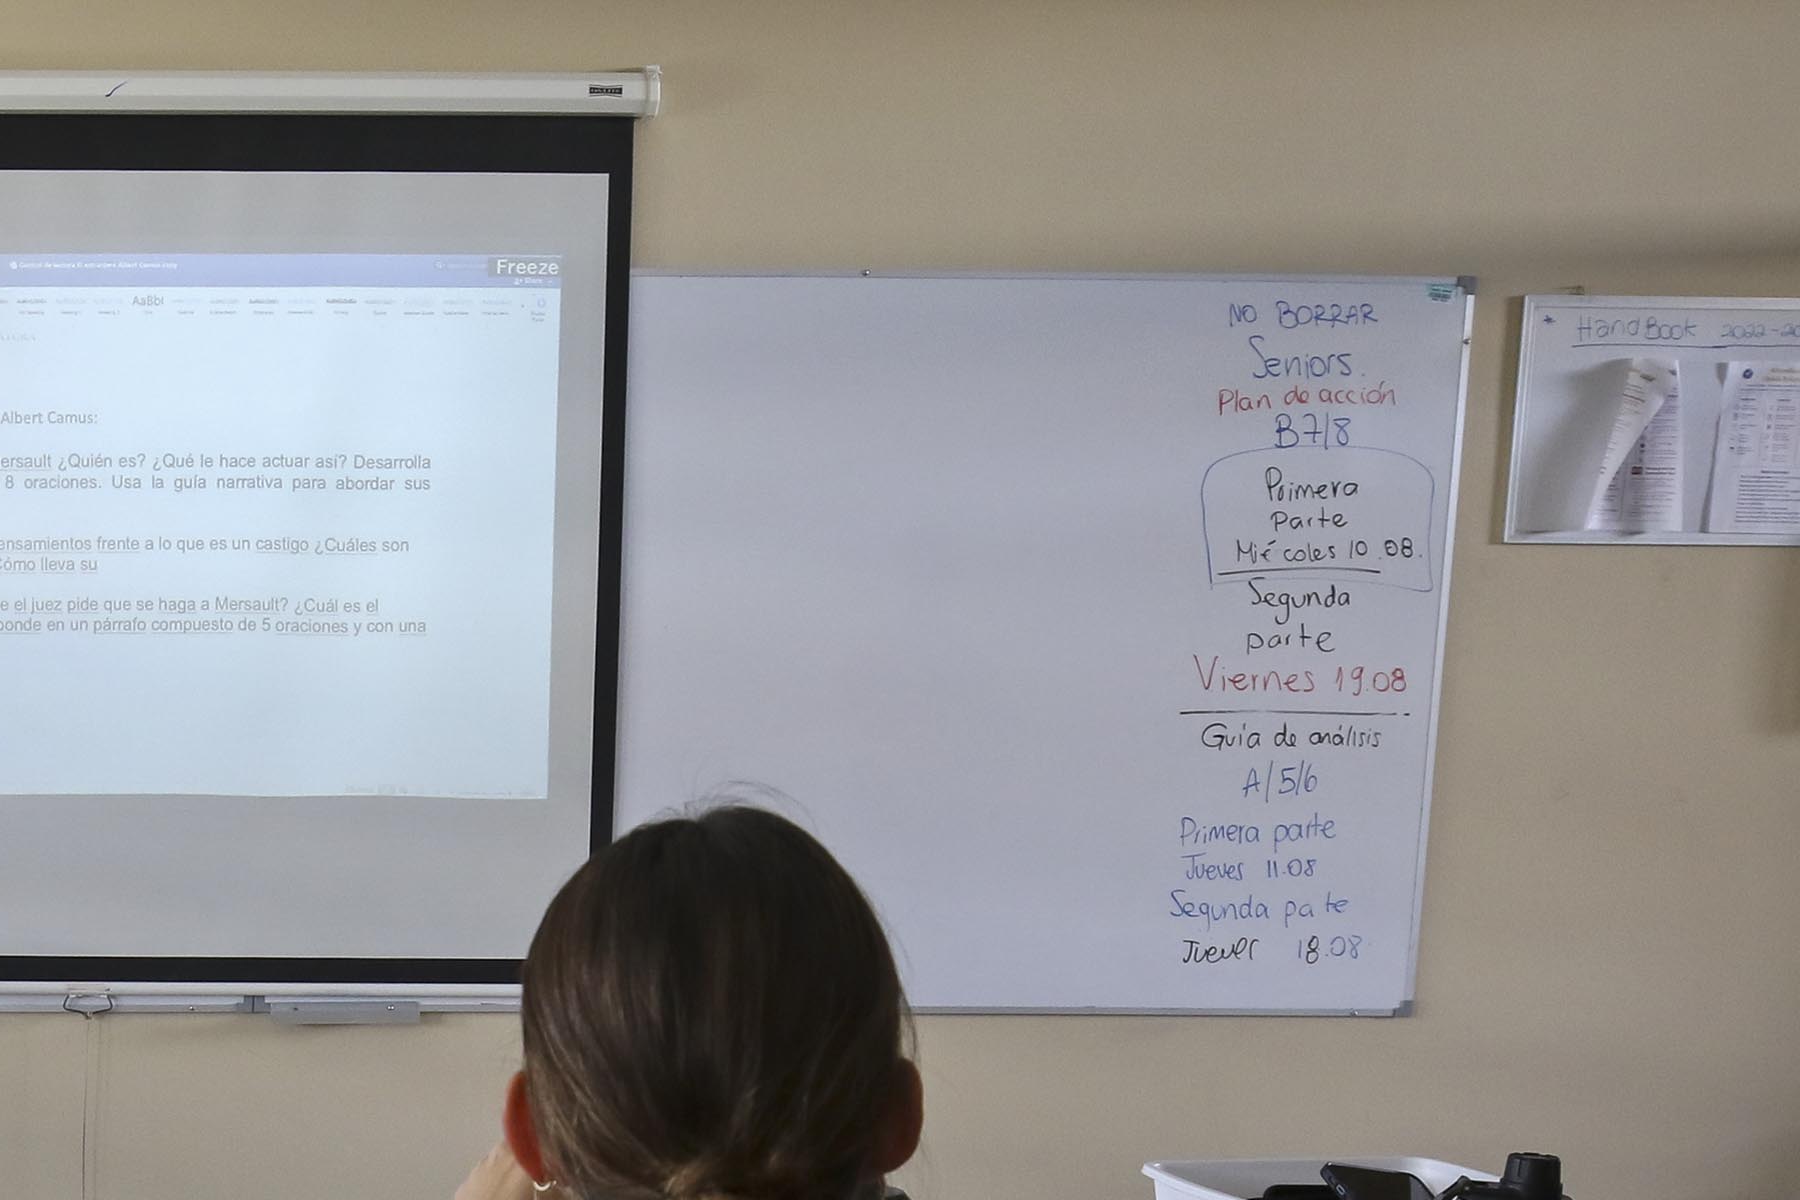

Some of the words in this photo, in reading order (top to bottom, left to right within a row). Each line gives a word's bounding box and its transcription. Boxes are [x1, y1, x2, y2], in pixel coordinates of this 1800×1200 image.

[496, 259, 561, 276] Freeze
[1228, 303, 1258, 328] NO
[1276, 300, 1379, 329] BORRAR
[1218, 388, 1272, 416] Plan
[1283, 384, 1310, 406] de
[1319, 380, 1397, 406] acción
[0, 411, 44, 424] Albert
[47, 411, 98, 424] Camus:
[58, 454, 113, 470] ¿Quién
[118, 454, 146, 467] es?
[152, 454, 194, 471] ¿Qué
[200, 454, 214, 467] le
[219, 454, 256, 467] hace
[262, 455, 310, 467] actuar
[315, 455, 348, 468] así?
[353, 455, 431, 469] Desarrolla
[4, 475, 15, 489] 8
[23, 475, 102, 489] oraciones.
[111, 475, 142, 488] Usa
[151, 475, 165, 488] la
[173, 475, 207, 492] guía
[216, 475, 283, 488] narrativa
[291, 478, 327, 492] para
[335, 476, 396, 490] abordar
[404, 479, 431, 490] sus
[96, 536, 140, 553] frente
[144, 539, 154, 550] a
[158, 536, 173, 550] lo
[176, 540, 205, 554] que
[209, 539, 228, 550] es
[231, 539, 251, 550] un
[255, 537, 310, 555] castigo
[314, 538, 377, 555] ¿Cuáles
[381, 541, 410, 552] son
[1236, 539, 1337, 564] Miércoles
[40, 558, 76, 571] lleva
[79, 560, 99, 572] su
[14, 598, 27, 614] el
[30, 598, 62, 614] juez
[66, 597, 99, 613] pide
[103, 600, 132, 614] que
[135, 600, 154, 611] se
[158, 597, 196, 614] haga
[200, 600, 210, 610] a
[215, 596, 289, 614] Mersault?
[294, 598, 338, 616] ¿Cuál
[343, 602, 361, 613] es
[365, 598, 379, 615] el
[1248, 577, 1352, 618] Segunda
[46, 621, 65, 632] en
[69, 621, 89, 632] un
[92, 618, 146, 634] párrafo
[151, 619, 234, 635] compuesto
[237, 619, 257, 632] de
[262, 619, 272, 632] 5
[275, 620, 348, 633] oraciones
[352, 623, 363, 636] y
[366, 622, 394, 633] con
[398, 622, 427, 633] una
[1245, 622, 1337, 655] parte
[1192, 653, 1316, 693] Viernes
[1201, 721, 1261, 750] Guía
[1273, 723, 1297, 748] de
[1179, 816, 1261, 848] Primera
[1273, 812, 1338, 853] parte
[1180, 850, 1244, 881] Jueves
[1169, 888, 1270, 932] Segunda
